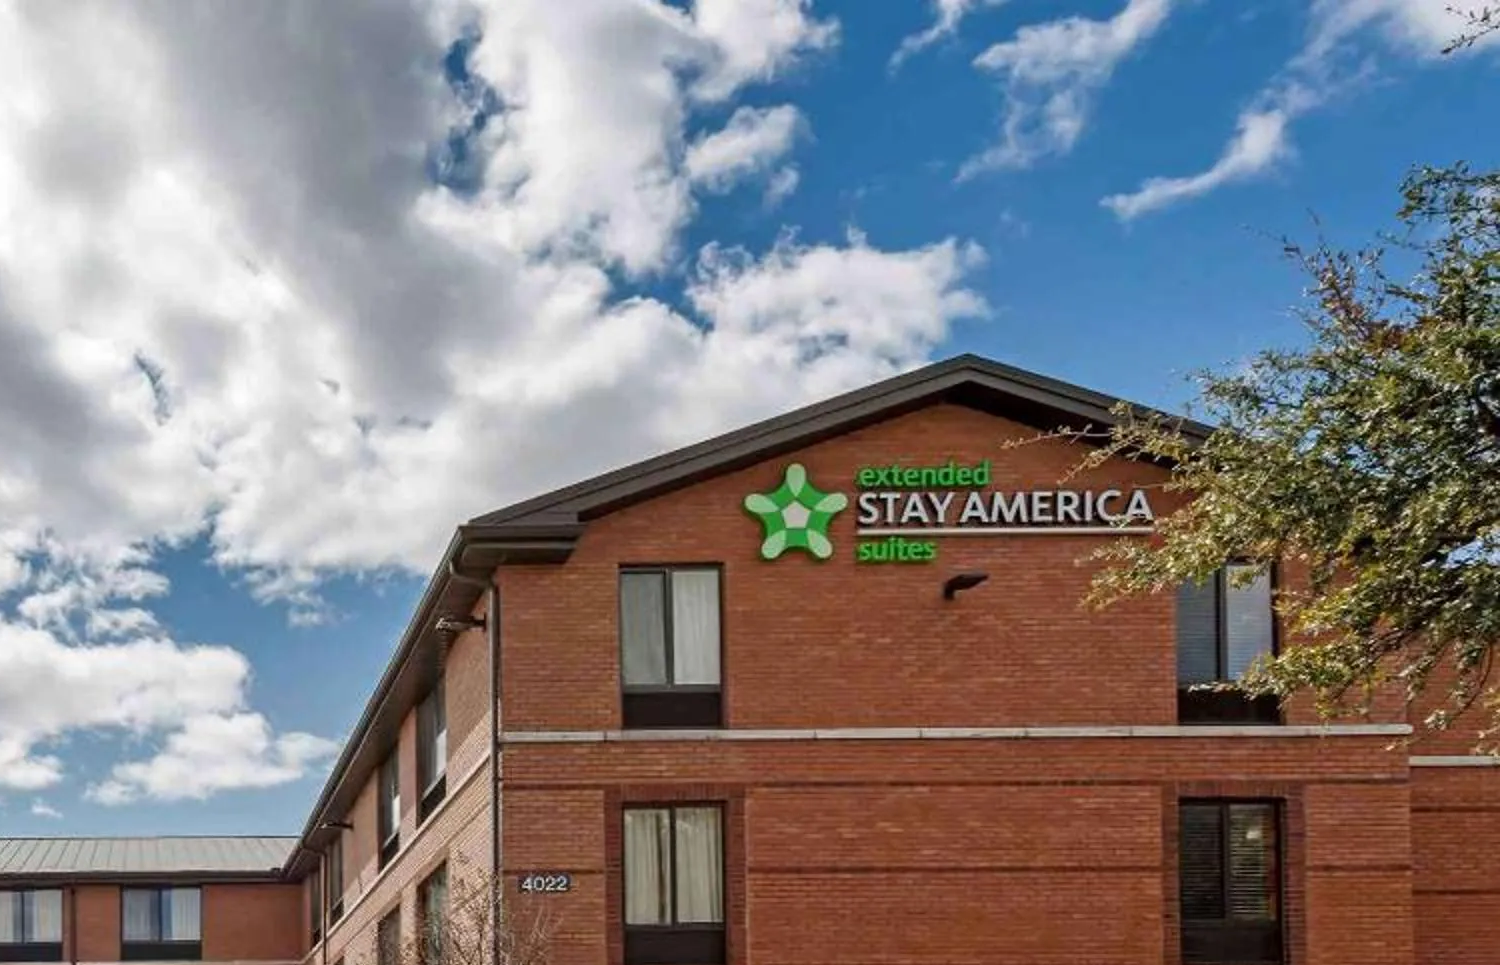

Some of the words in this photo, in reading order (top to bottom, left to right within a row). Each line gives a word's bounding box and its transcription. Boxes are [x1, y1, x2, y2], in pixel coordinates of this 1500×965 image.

[858, 460, 991, 486] extended
[858, 491, 956, 524] STAY
[959, 489, 1155, 523] AMERICA
[858, 537, 937, 561] suites
[520, 875, 568, 892] 4022
